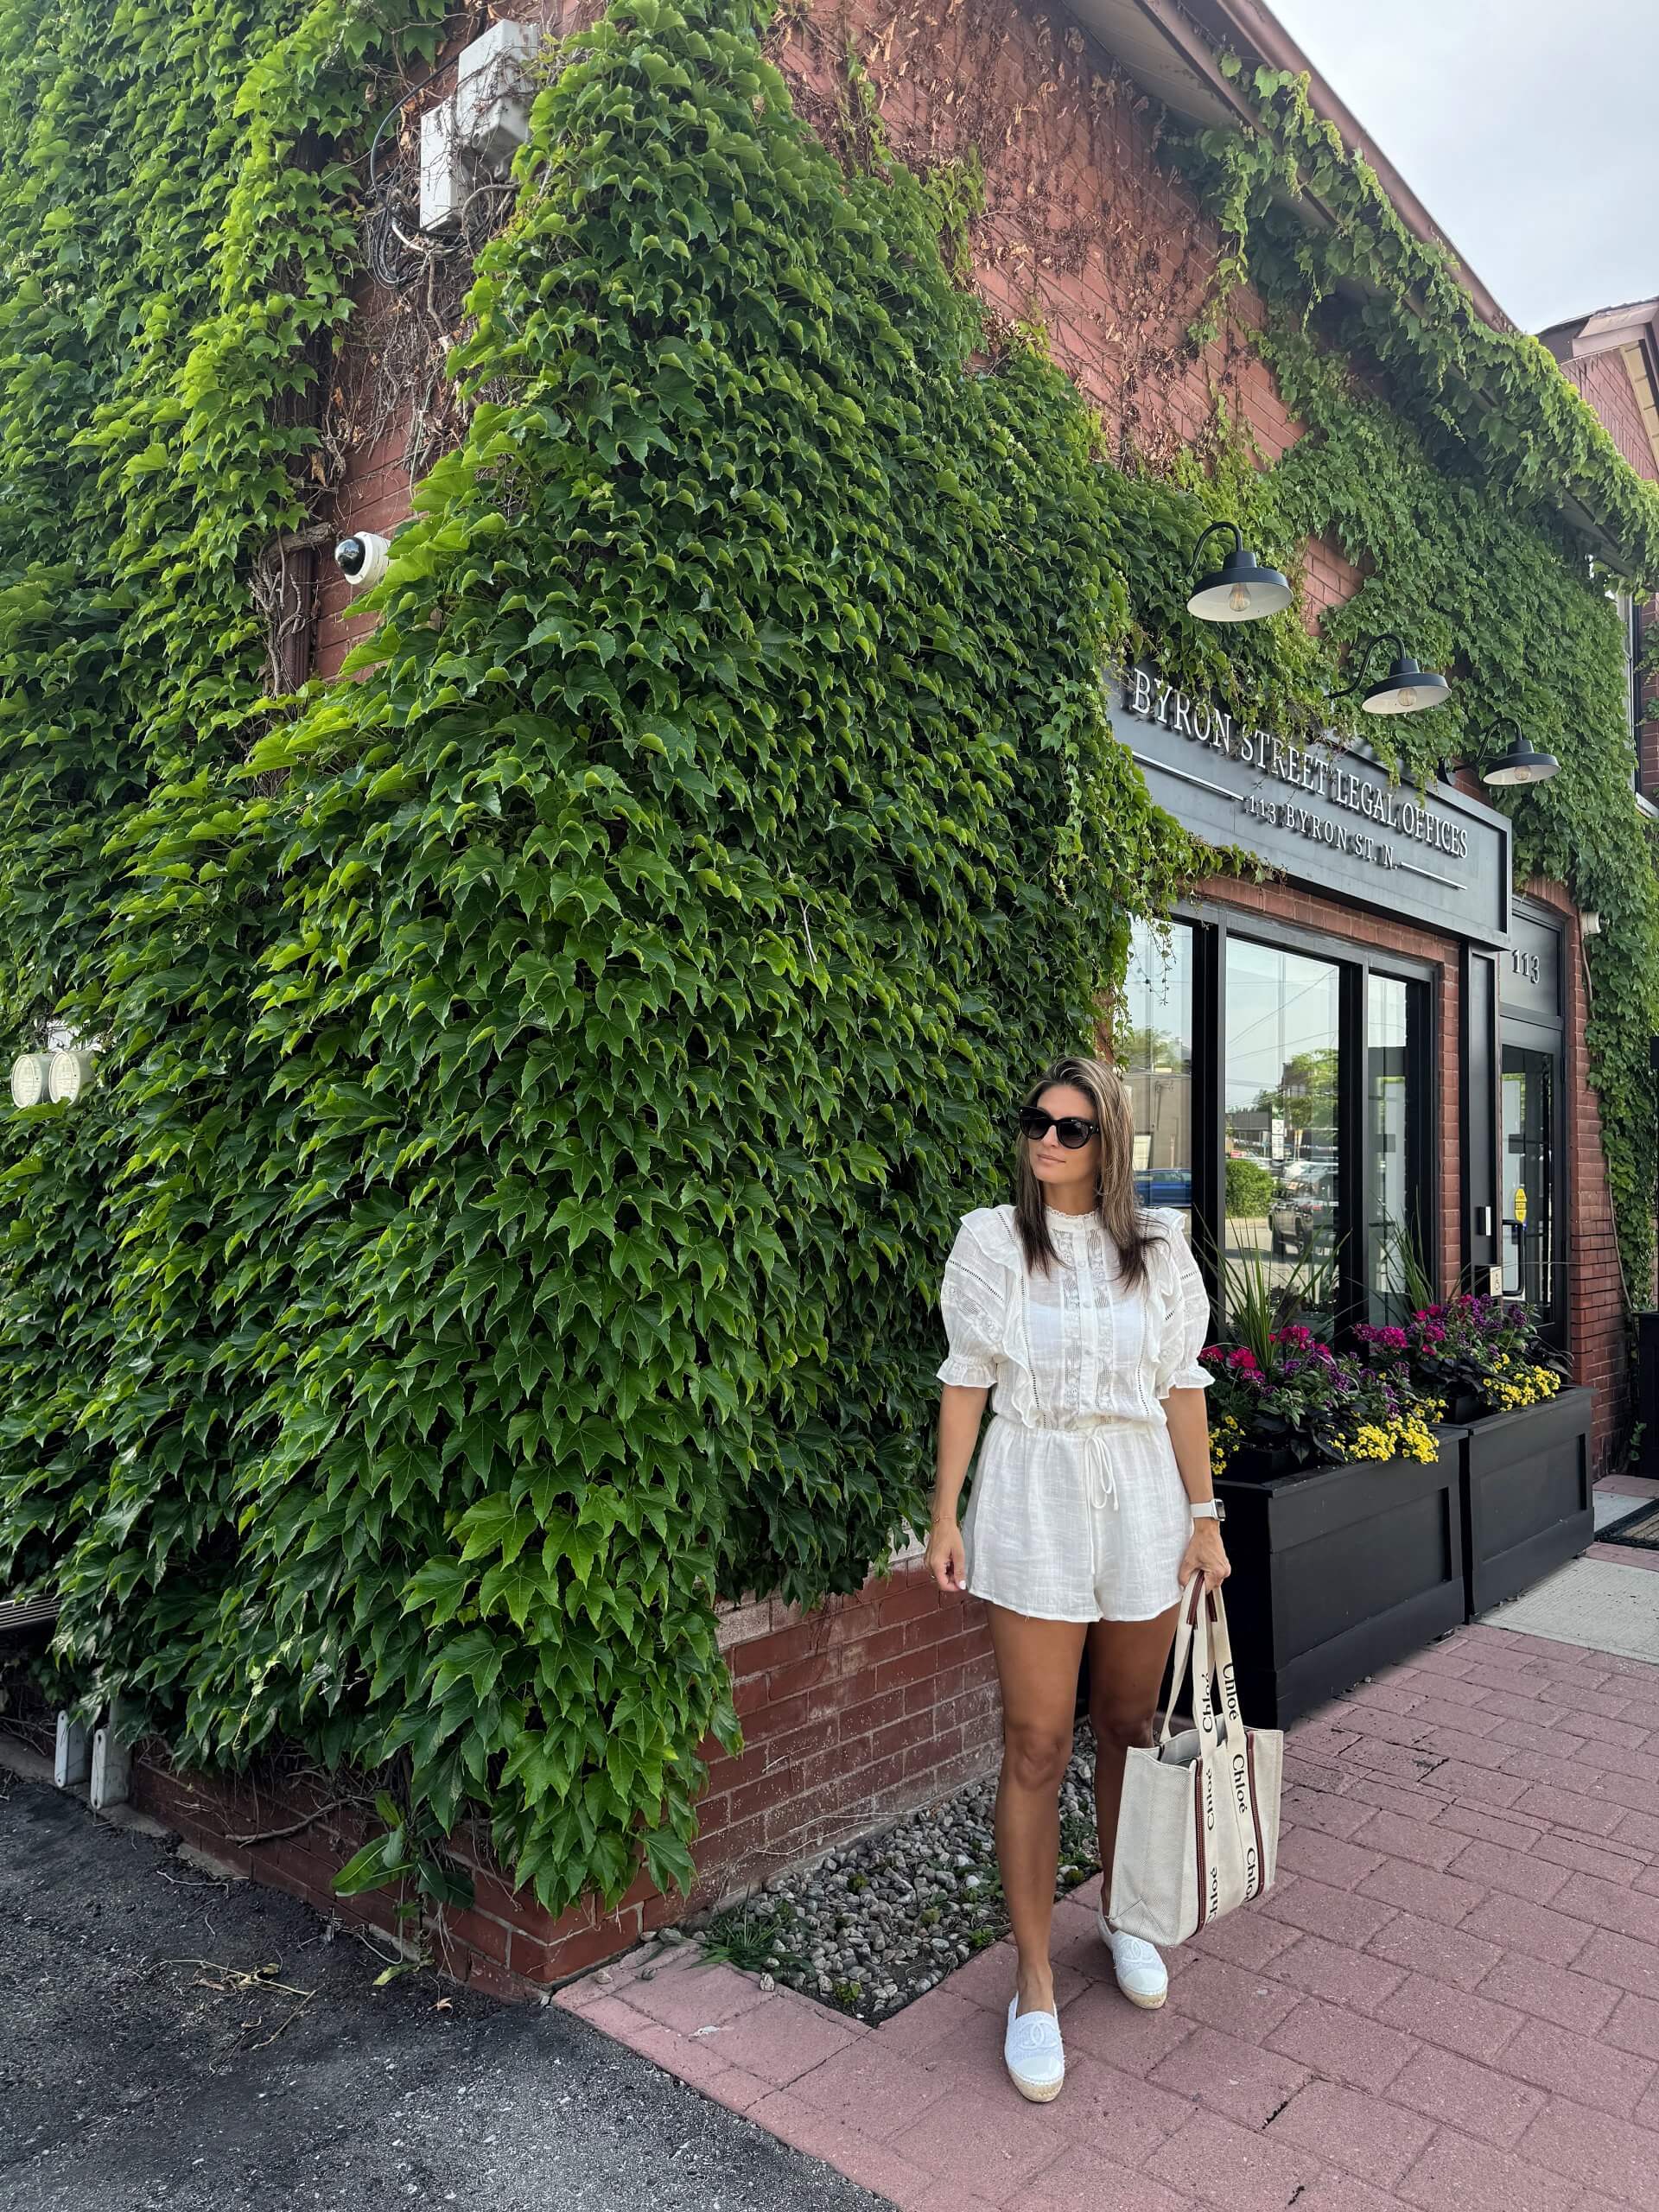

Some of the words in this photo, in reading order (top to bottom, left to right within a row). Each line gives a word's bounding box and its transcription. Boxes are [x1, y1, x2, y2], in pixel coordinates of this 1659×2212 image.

[1133, 667, 1231, 753] BYRON
[1241, 724, 1329, 795] STREET
[1336, 768, 1396, 827] LEGAL
[1402, 802, 1468, 859] OFFICES
[1248, 795, 1276, 823] 113
[1285, 804, 1348, 851] BYRON
[1355, 833, 1376, 861] ST.
[1383, 843, 1397, 871] N.
[1512, 950, 1540, 984] 113
[1233, 1754, 1247, 1814] Chloé
